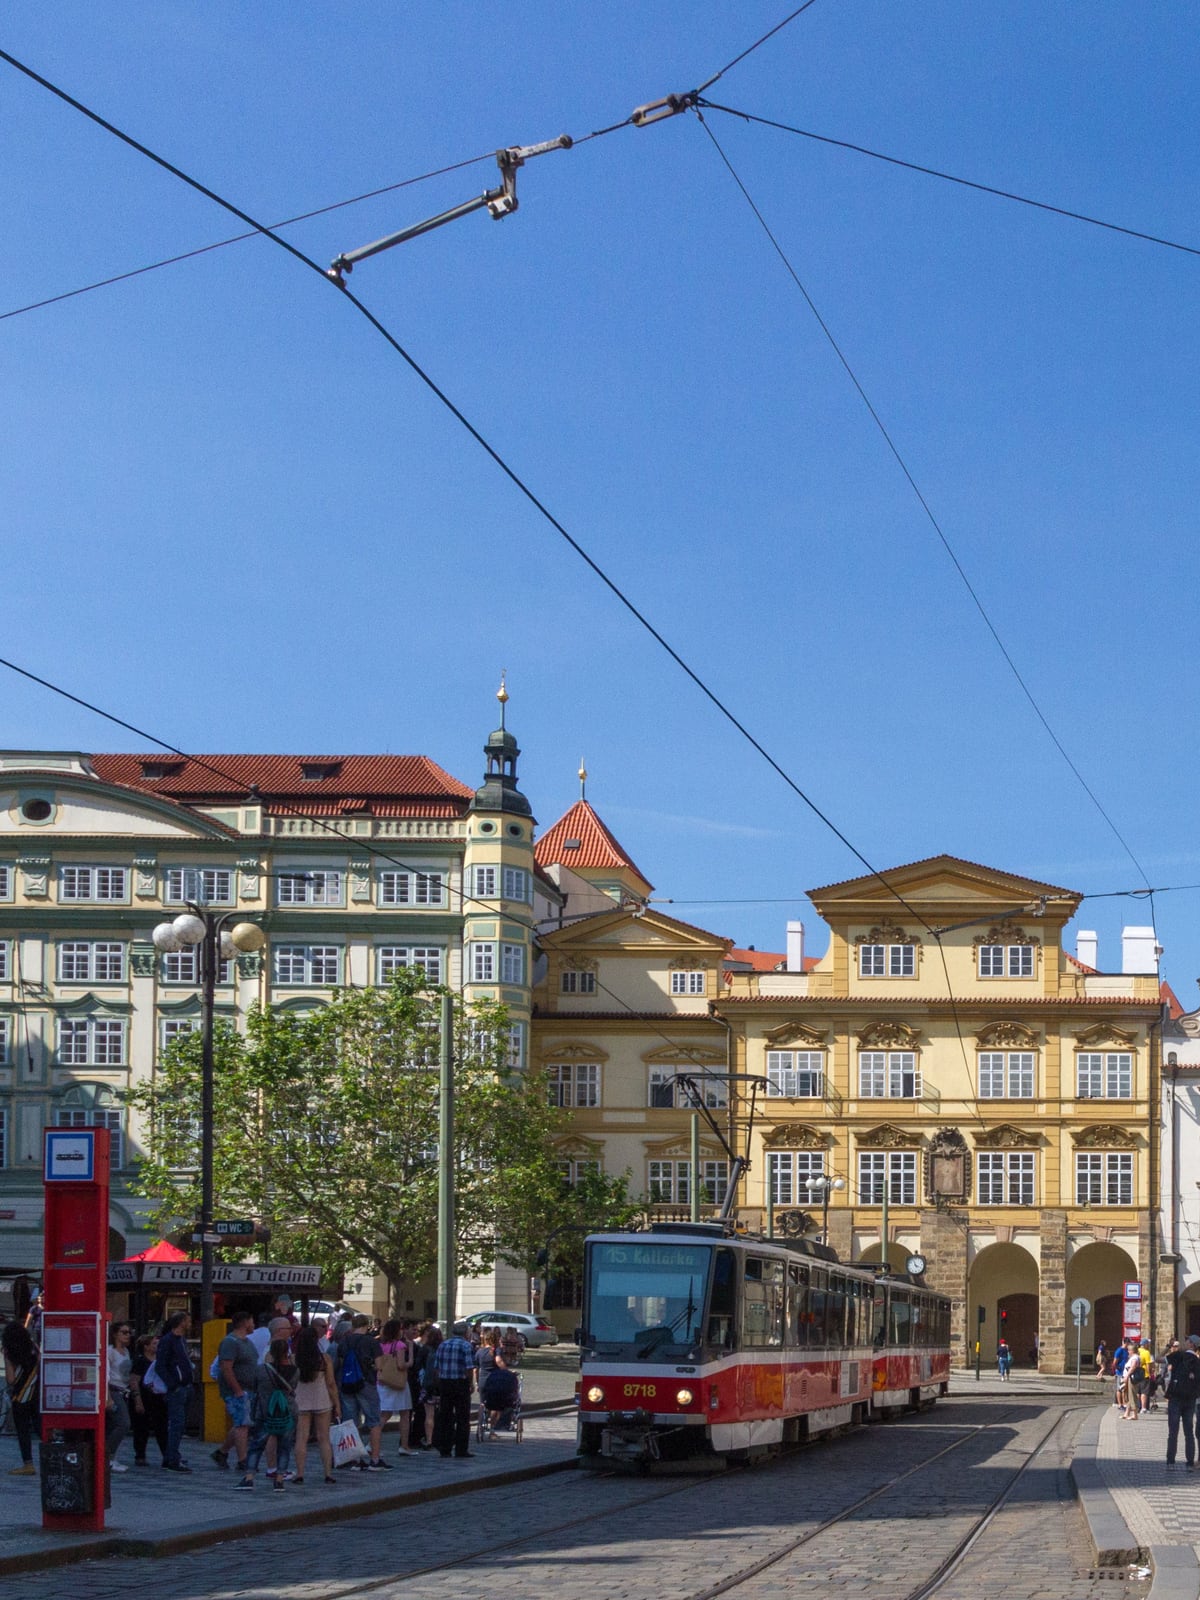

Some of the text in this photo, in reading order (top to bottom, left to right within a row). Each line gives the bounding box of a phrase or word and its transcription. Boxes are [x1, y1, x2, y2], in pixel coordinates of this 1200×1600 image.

[228, 1223, 242, 1233] WC
[607, 1247, 627, 1264] 15
[240, 1268, 316, 1283] Trdelník
[624, 1384, 657, 1397] 8718
